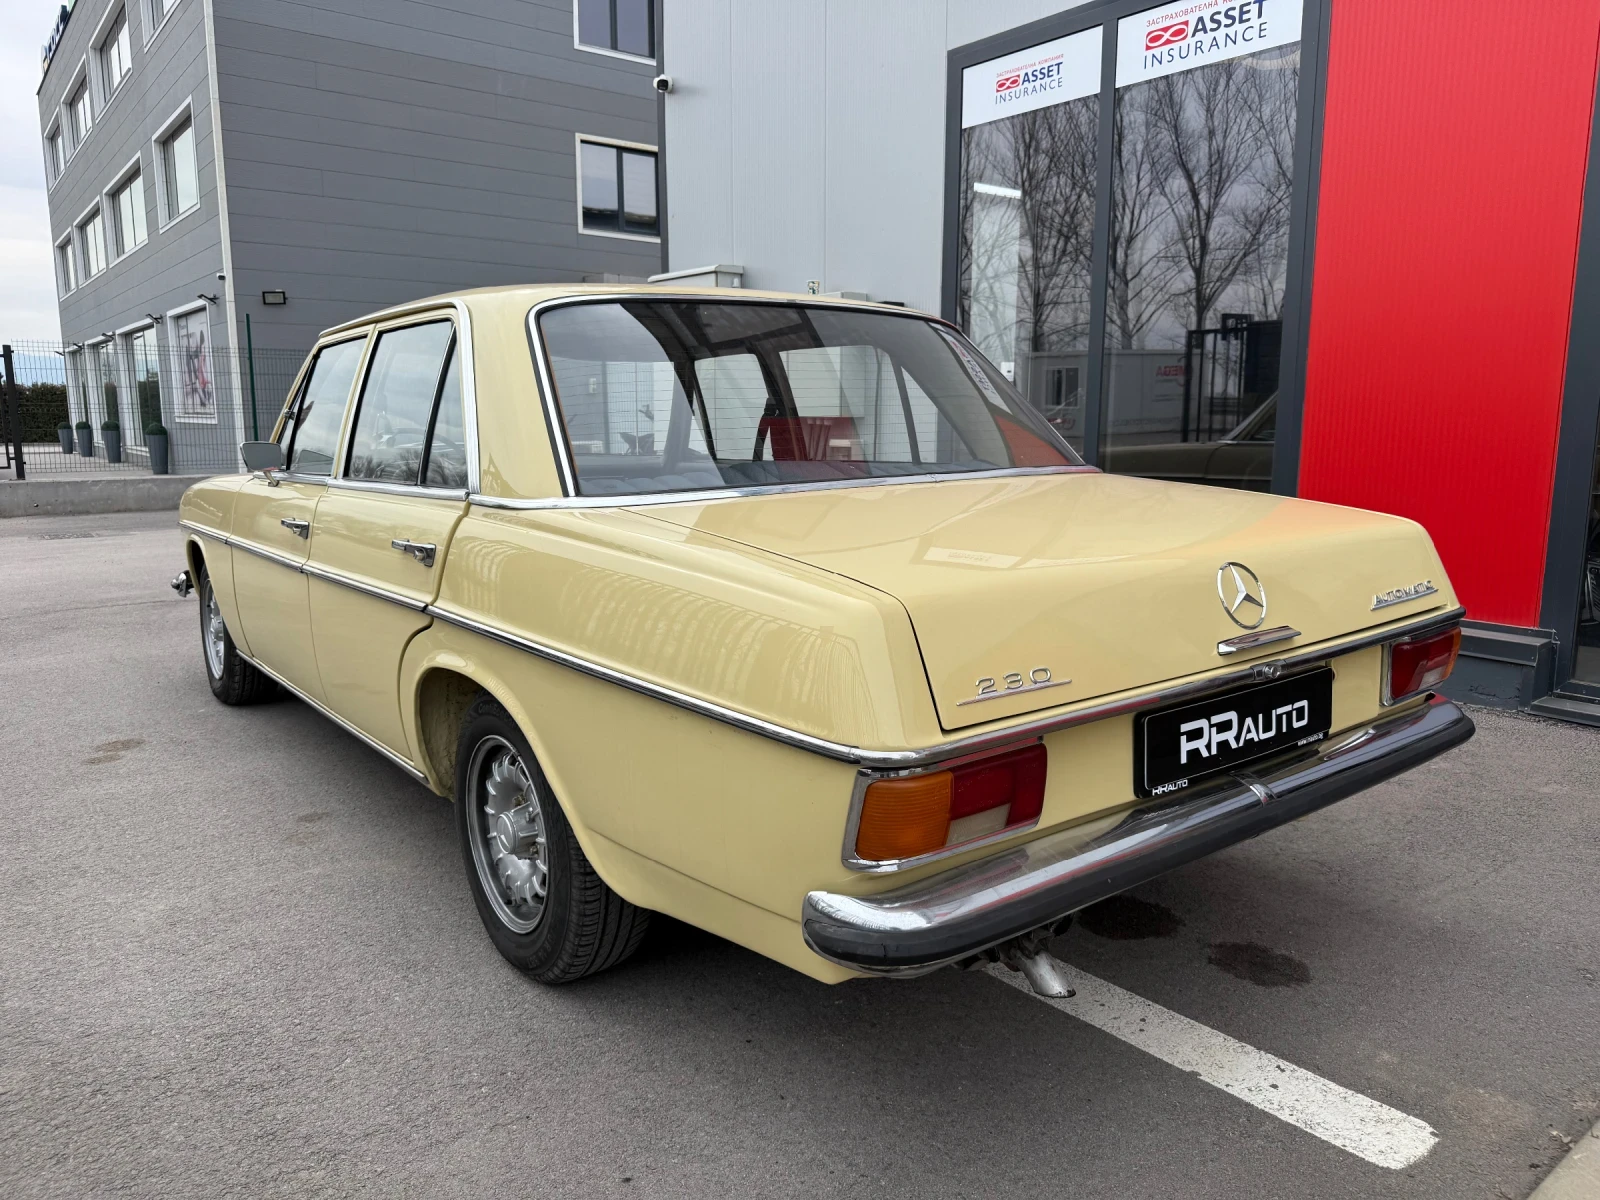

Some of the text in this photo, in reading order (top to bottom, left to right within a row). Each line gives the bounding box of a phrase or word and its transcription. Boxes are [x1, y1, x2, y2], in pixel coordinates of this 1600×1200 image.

[1146, 0, 1219, 27] ЗАСТРАХОВАТЕЛНА
[1191, 0, 1265, 38] ASSET
[1144, 22, 1268, 70] INSURANCE
[1021, 62, 1063, 86] ASSET
[995, 77, 1063, 105] INSURANCE
[1371, 580, 1435, 605] AUTOMATIC
[975, 667, 1051, 695] 230
